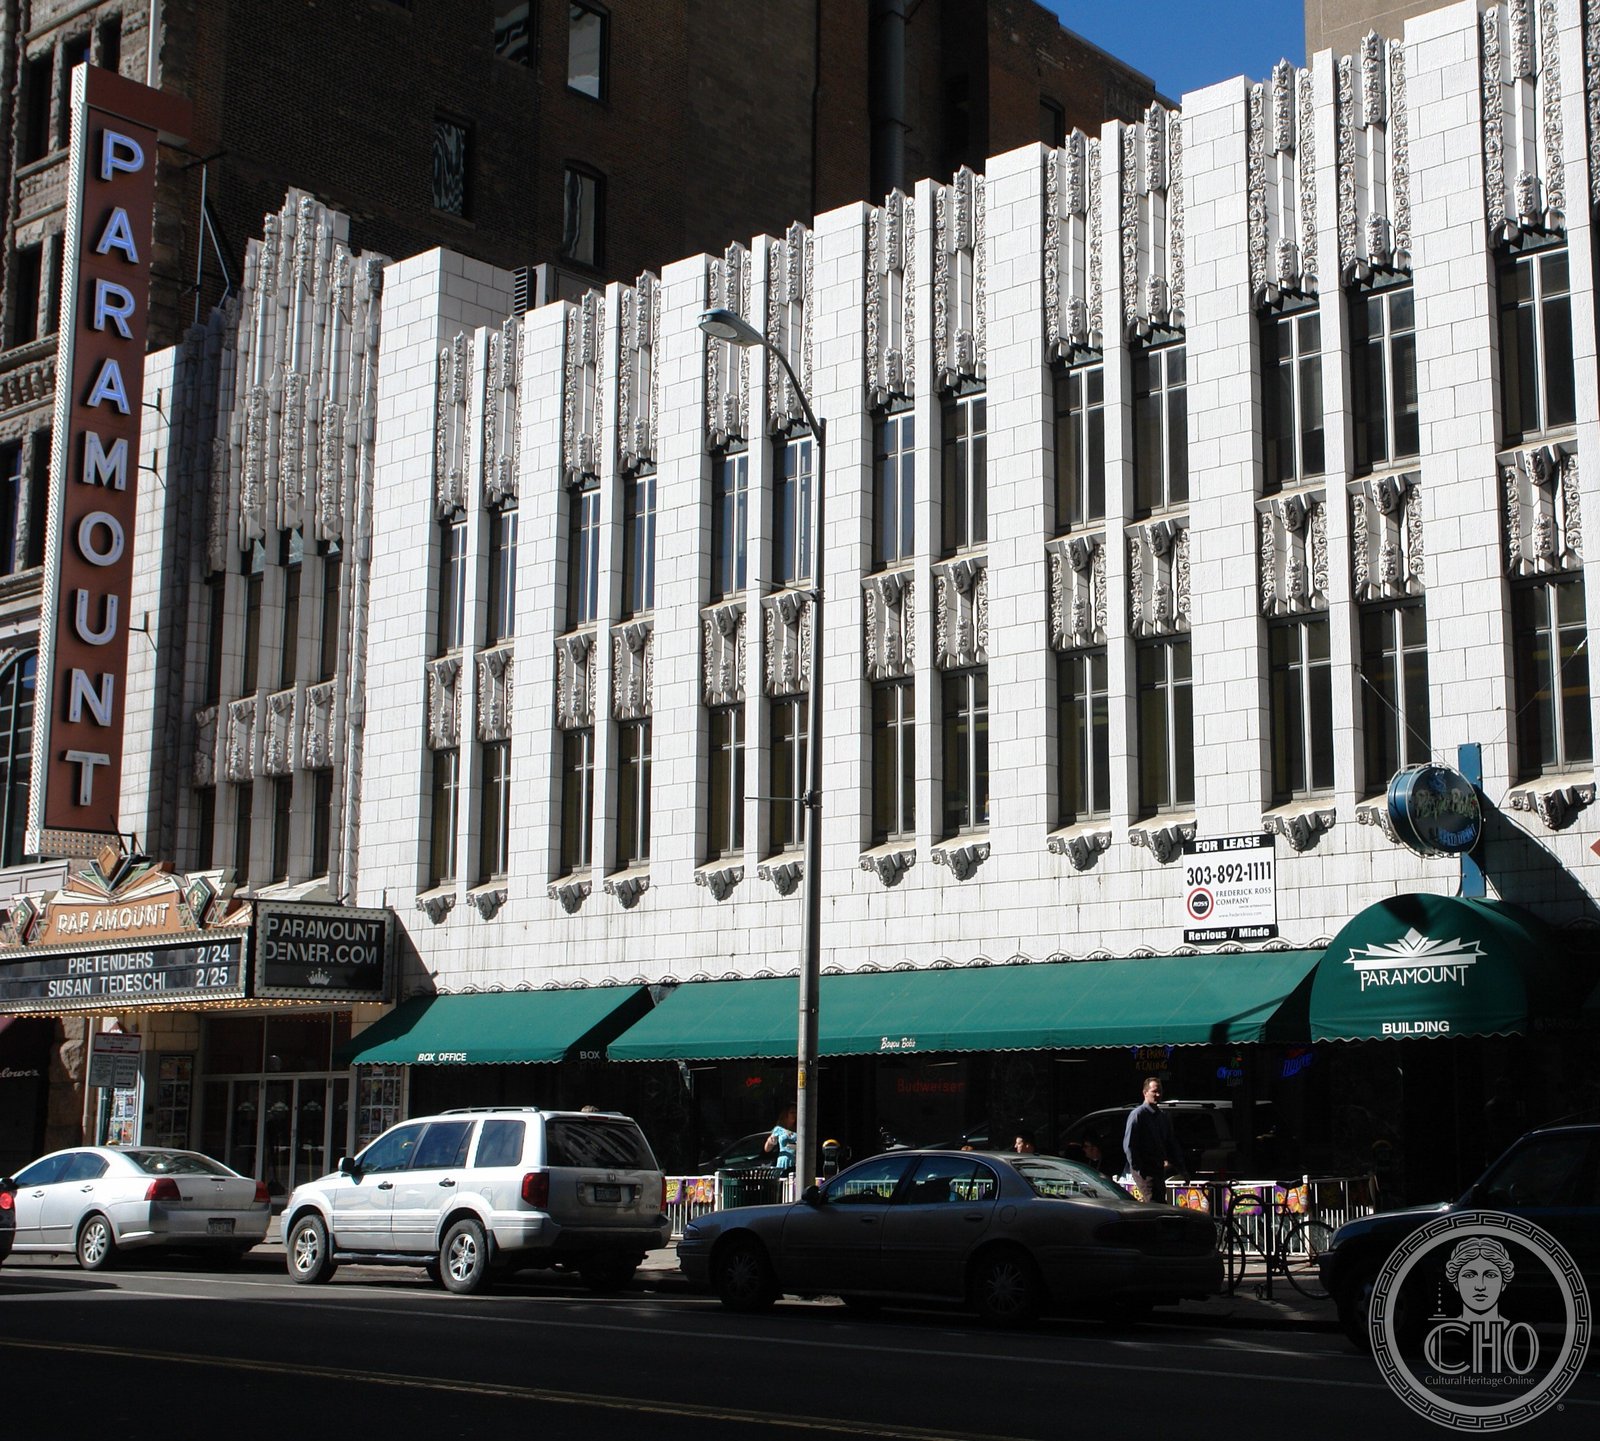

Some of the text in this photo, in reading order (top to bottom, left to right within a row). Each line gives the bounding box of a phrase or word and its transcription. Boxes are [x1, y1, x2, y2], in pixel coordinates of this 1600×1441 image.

[65, 128, 145, 807] PARAMOUNT
[1195, 836, 1261, 852] FOR LEASE
[1186, 861, 1272, 886] 303-892-1111
[1215, 886, 1272, 898] FREDERICK ROSS
[1215, 897, 1249, 906] COMPANY
[57, 902, 170, 935] PARAMOUNT
[267, 917, 380, 942] PARAMOUNT
[1188, 930, 1227, 941] Revious
[1239, 927, 1270, 938] Minde
[196, 944, 231, 964] 2/24
[266, 941, 377, 965] DENVER.COM
[68, 952, 154, 975] PRETENDERS
[48, 971, 167, 999] SUSAN TEDESCHI
[195, 966, 229, 987] 2/25
[1360, 965, 1469, 992] PARAMOUNT
[1382, 1020, 1450, 1035] BUILDING
[417, 1052, 467, 1062] BOX OFFICE
[580, 1050, 601, 1060] BOX
[896, 1077, 967, 1095] Budweiser
